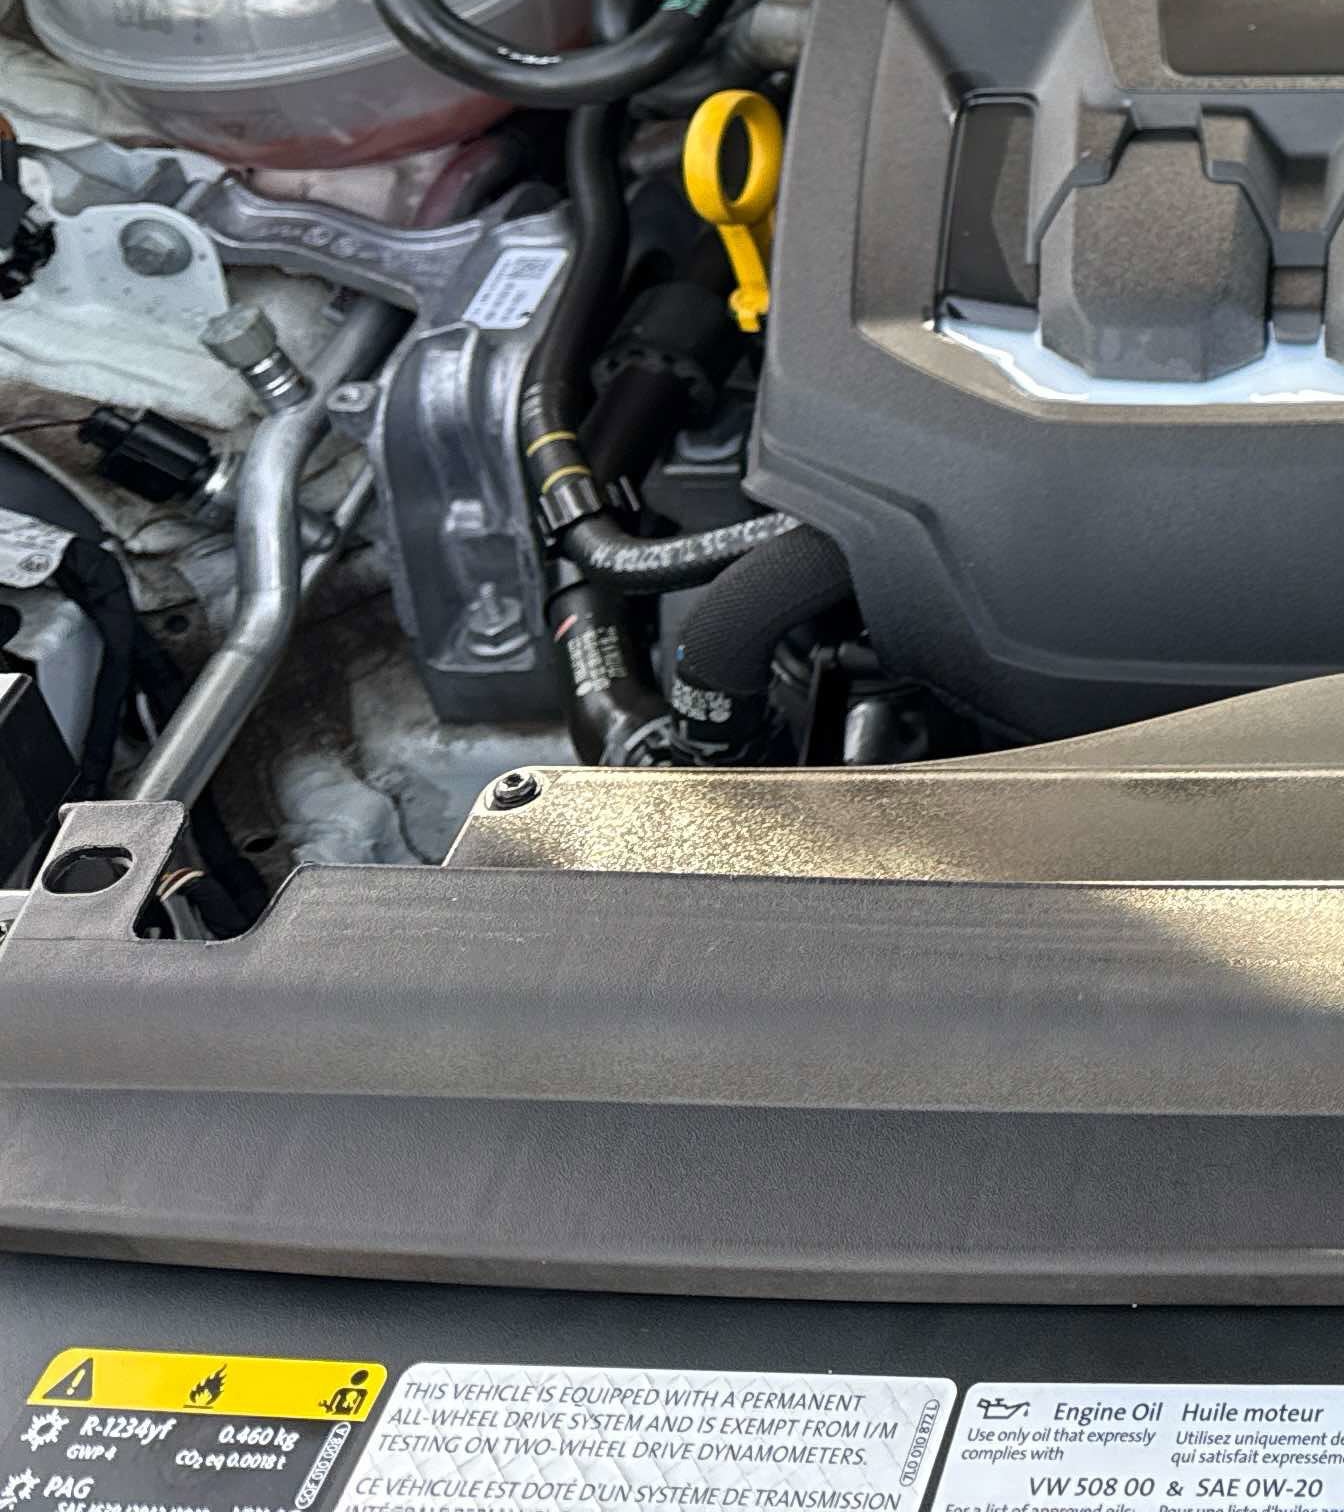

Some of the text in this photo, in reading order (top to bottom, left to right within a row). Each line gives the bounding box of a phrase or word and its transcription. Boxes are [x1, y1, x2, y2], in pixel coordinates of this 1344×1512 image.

[404, 1382, 866, 1412] THIS VEHICLE IS EQUIPPED WITH A PERMANENT
[388, 1408, 898, 1439] ALL-WHEEL DRIVE SYSTEM AND IS EXEMPT FROM I/M
[1053, 1401, 1324, 1427] Engine Oil Huile moteur
[80, 1415, 299, 1452] R-1234yf 0.460 kg
[967, 1427, 1156, 1446] Use only oil that expressly
[1175, 1430, 1231, 1446] Utilisez
[1235, 1431, 1327, 1449] uniquement
[66, 1444, 118, 1461] GWP 4
[378, 1434, 868, 1466] TESTING ON TWO-WHEEL DRIVE DYNAMOMETERS.
[961, 1446, 1064, 1464] complies with
[1170, 1450, 1196, 1468] qui
[1198, 1449, 1258, 1464] satisfait
[206, 1454, 225, 1470] eq
[43, 1476, 95, 1499] PAG
[355, 1472, 901, 1512] CE VÉHICULE EST DOTÉ D'UN SYSTÈME DE TRANSMISSION
[1029, 1476, 1324, 1498] VW 508 00 & SAE 0W-20
